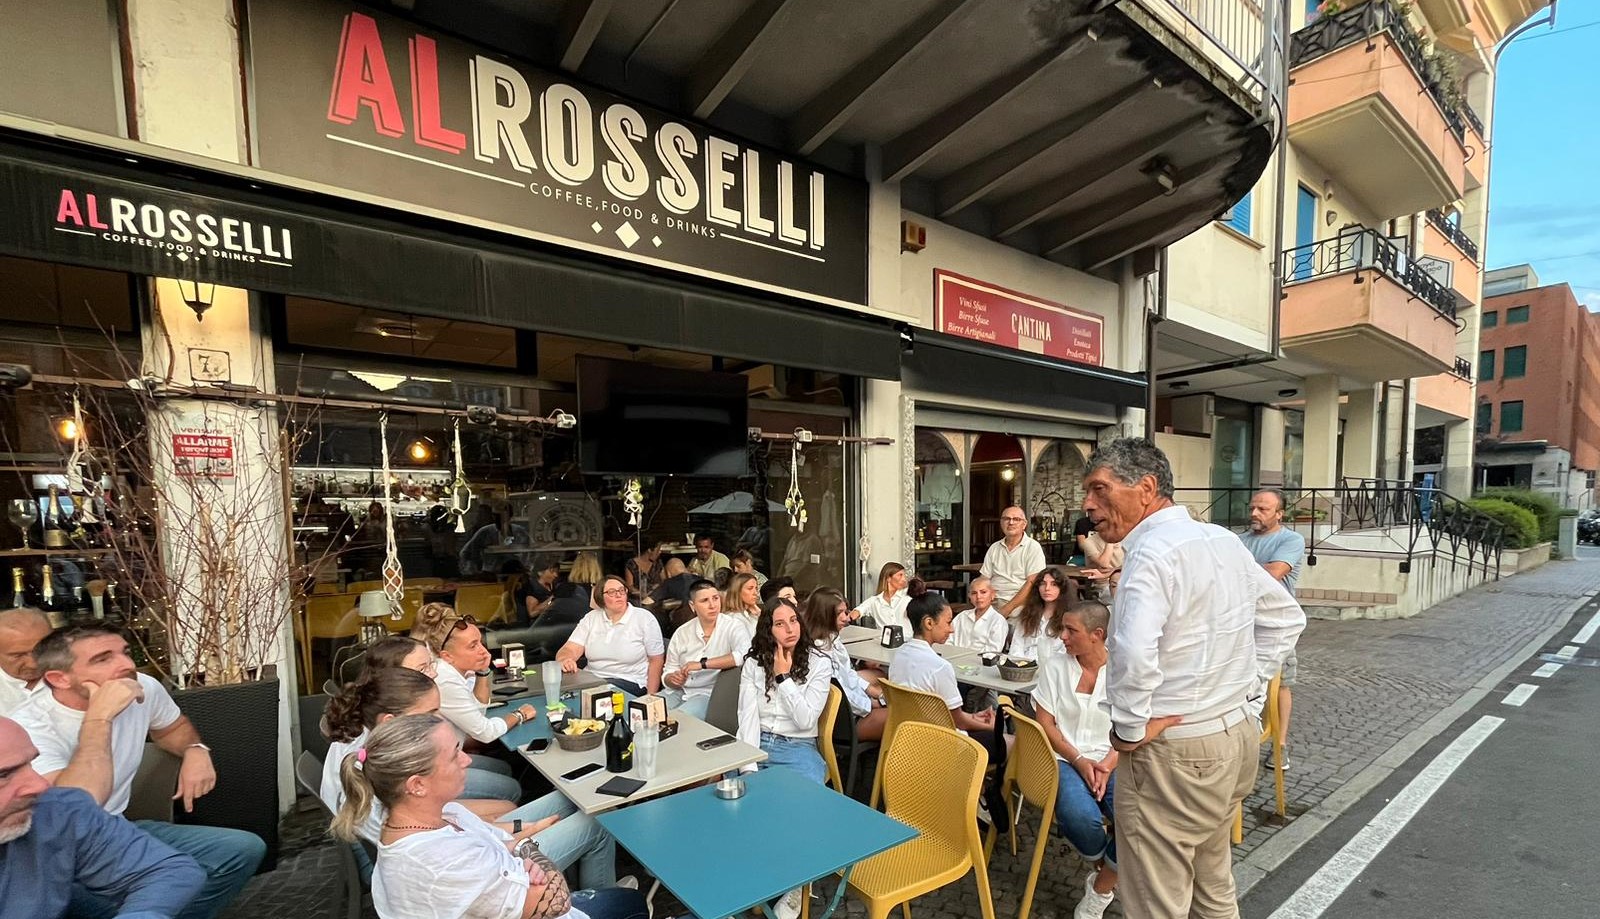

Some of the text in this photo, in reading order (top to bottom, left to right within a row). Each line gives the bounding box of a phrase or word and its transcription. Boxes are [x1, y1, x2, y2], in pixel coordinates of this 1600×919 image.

[650, 212, 660, 223] &
[666, 217, 717, 239] DRINKS
[199, 247, 207, 255] &
[212, 249, 256, 263] DRINKS
[959, 297, 987, 312] Vini Sfusi
[958, 310, 990, 326] Birre Sfuse
[947, 322, 997, 341] Birre Artigianali
[1011, 312, 1052, 342] CANTINA
[176, 437, 229, 447] ALLARME
